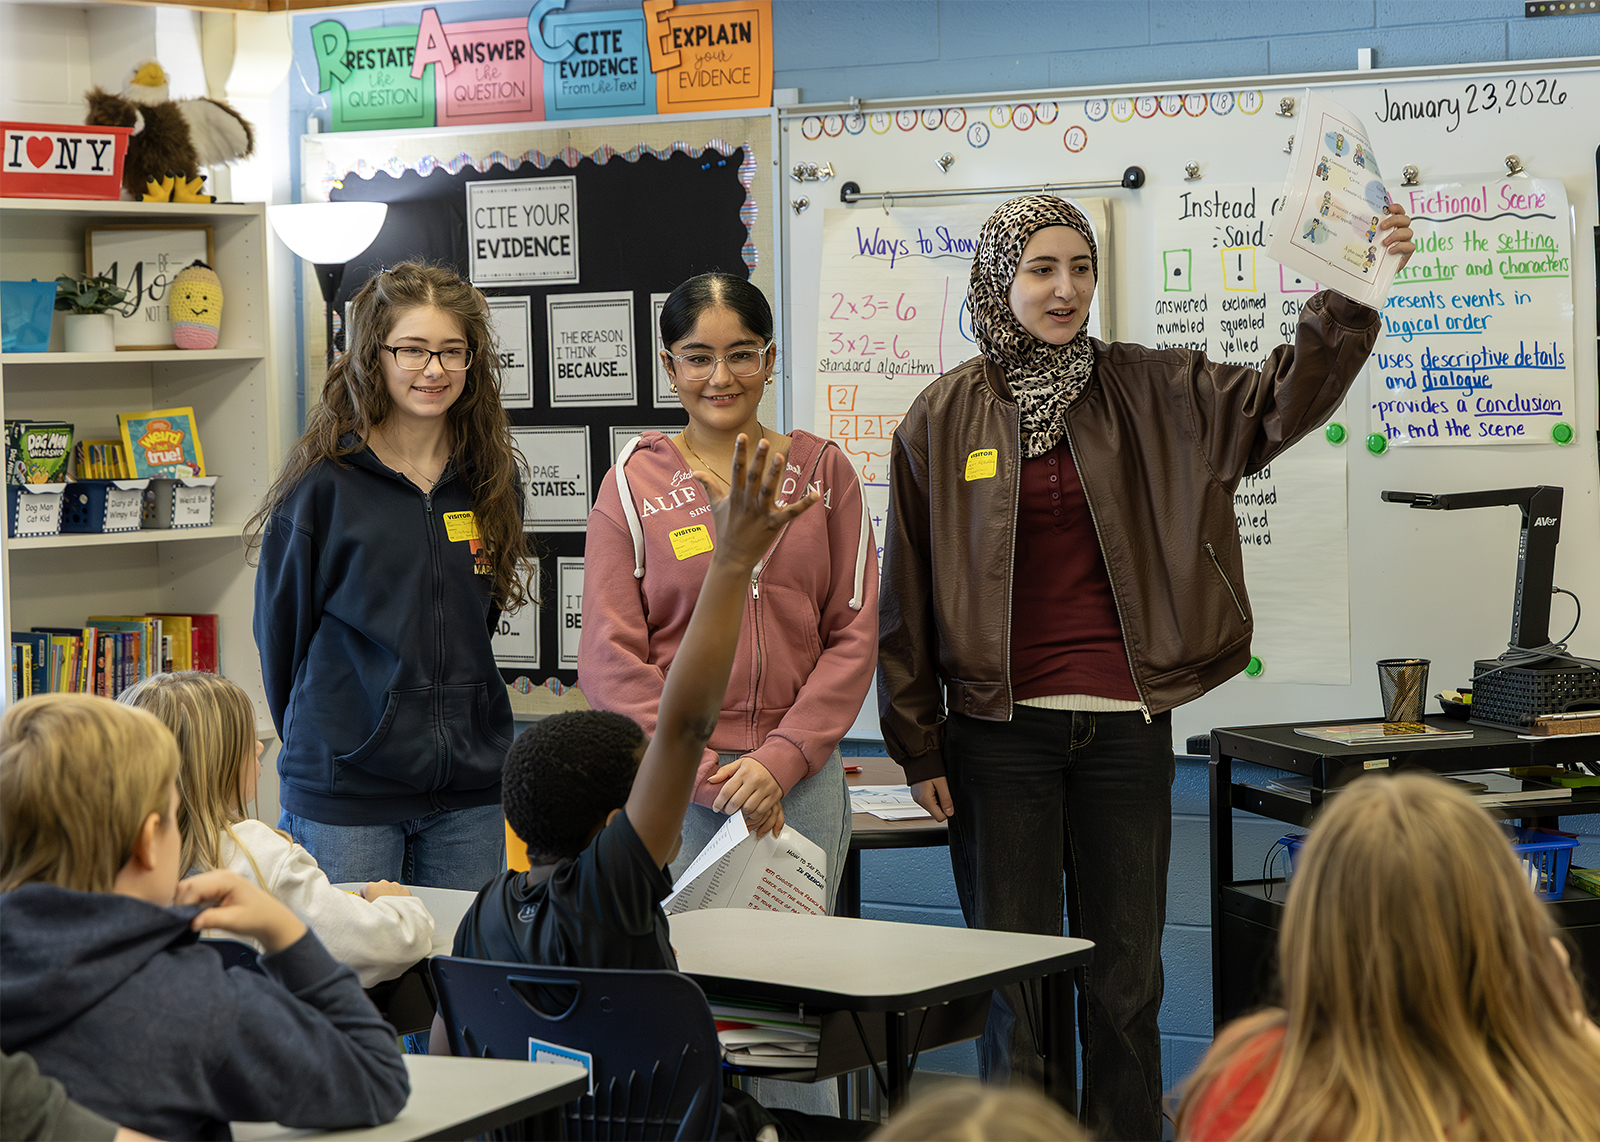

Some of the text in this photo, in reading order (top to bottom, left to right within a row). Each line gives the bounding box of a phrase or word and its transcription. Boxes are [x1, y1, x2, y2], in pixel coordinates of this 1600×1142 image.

[574, 29, 623, 55] CITE
[673, 20, 752, 49] EXPLAIN
[346, 46, 414, 70] RESTATE
[451, 39, 526, 64] ANSWER
[694, 50, 733, 69] your
[475, 64, 502, 83] the
[560, 56, 639, 79] EVIDENCE
[369, 71, 395, 88] the
[562, 77, 637, 95] From the Text
[679, 67, 751, 89] EVIDENCE
[349, 87, 418, 108] QUESTION
[454, 80, 525, 102] QUESTION
[1245, 92, 1255, 108] 19
[1090, 100, 1101, 115] 13
[1117, 101, 1127, 115] 14
[1141, 97, 1151, 112] 15
[1166, 96, 1175, 112] 16
[1190, 95, 1201, 110] 17
[1215, 94, 1228, 109] 18
[1375, 88, 1460, 133] January
[1019, 112, 1028, 124] 10
[1041, 105, 1049, 119] 11
[1069, 132, 1079, 146] 12
[8, 135, 24, 168] I
[1178, 187, 1256, 221] Instead
[1409, 186, 1488, 214] Fictional
[1497, 184, 1546, 211] Scene
[474, 203, 570, 229] CITE YOUR
[1222, 221, 1266, 248] Said
[1463, 230, 1489, 252] the
[476, 235, 571, 260] EVIDENCE
[856, 226, 909, 269] Ways
[916, 227, 933, 254] to
[158, 253, 169, 273] BE
[1465, 258, 1493, 276] and
[1500, 254, 1569, 277] characters
[1155, 294, 1208, 316] answered
[1221, 293, 1267, 312] exclaimed
[1451, 288, 1505, 309] events
[1514, 290, 1531, 305] in
[145, 306, 160, 322] NOT
[1156, 317, 1205, 335] mumbled
[1220, 312, 1265, 338] squealed
[1385, 312, 1493, 343] logical order
[560, 329, 623, 344] THE REASON
[556, 344, 628, 360] I THINK IS
[1220, 336, 1259, 358] yelled
[1378, 340, 1566, 372] uses descriptive details
[557, 361, 628, 379] BECAUSE...
[818, 357, 935, 380] Standard algorithm
[1386, 370, 1492, 397] and dialogue
[836, 388, 848, 405] 2
[1378, 393, 1562, 421] provides a conclusion
[838, 419, 850, 436] 2
[863, 419, 875, 435] 2
[1383, 418, 1525, 440] to end the scene
[27, 433, 48, 451] DOG
[48, 432, 69, 449] MAN
[140, 430, 182, 449] weird
[147, 447, 182, 464] true!
[532, 465, 560, 478] PAGE
[861, 464, 876, 482] 6
[531, 481, 586, 497] STATES...
[25, 503, 54, 514] Dog Man
[111, 500, 126, 508] Diary
[127, 498, 134, 506] of
[26, 514, 50, 523] Cat Kid
[673, 526, 702, 537] VISITOR
